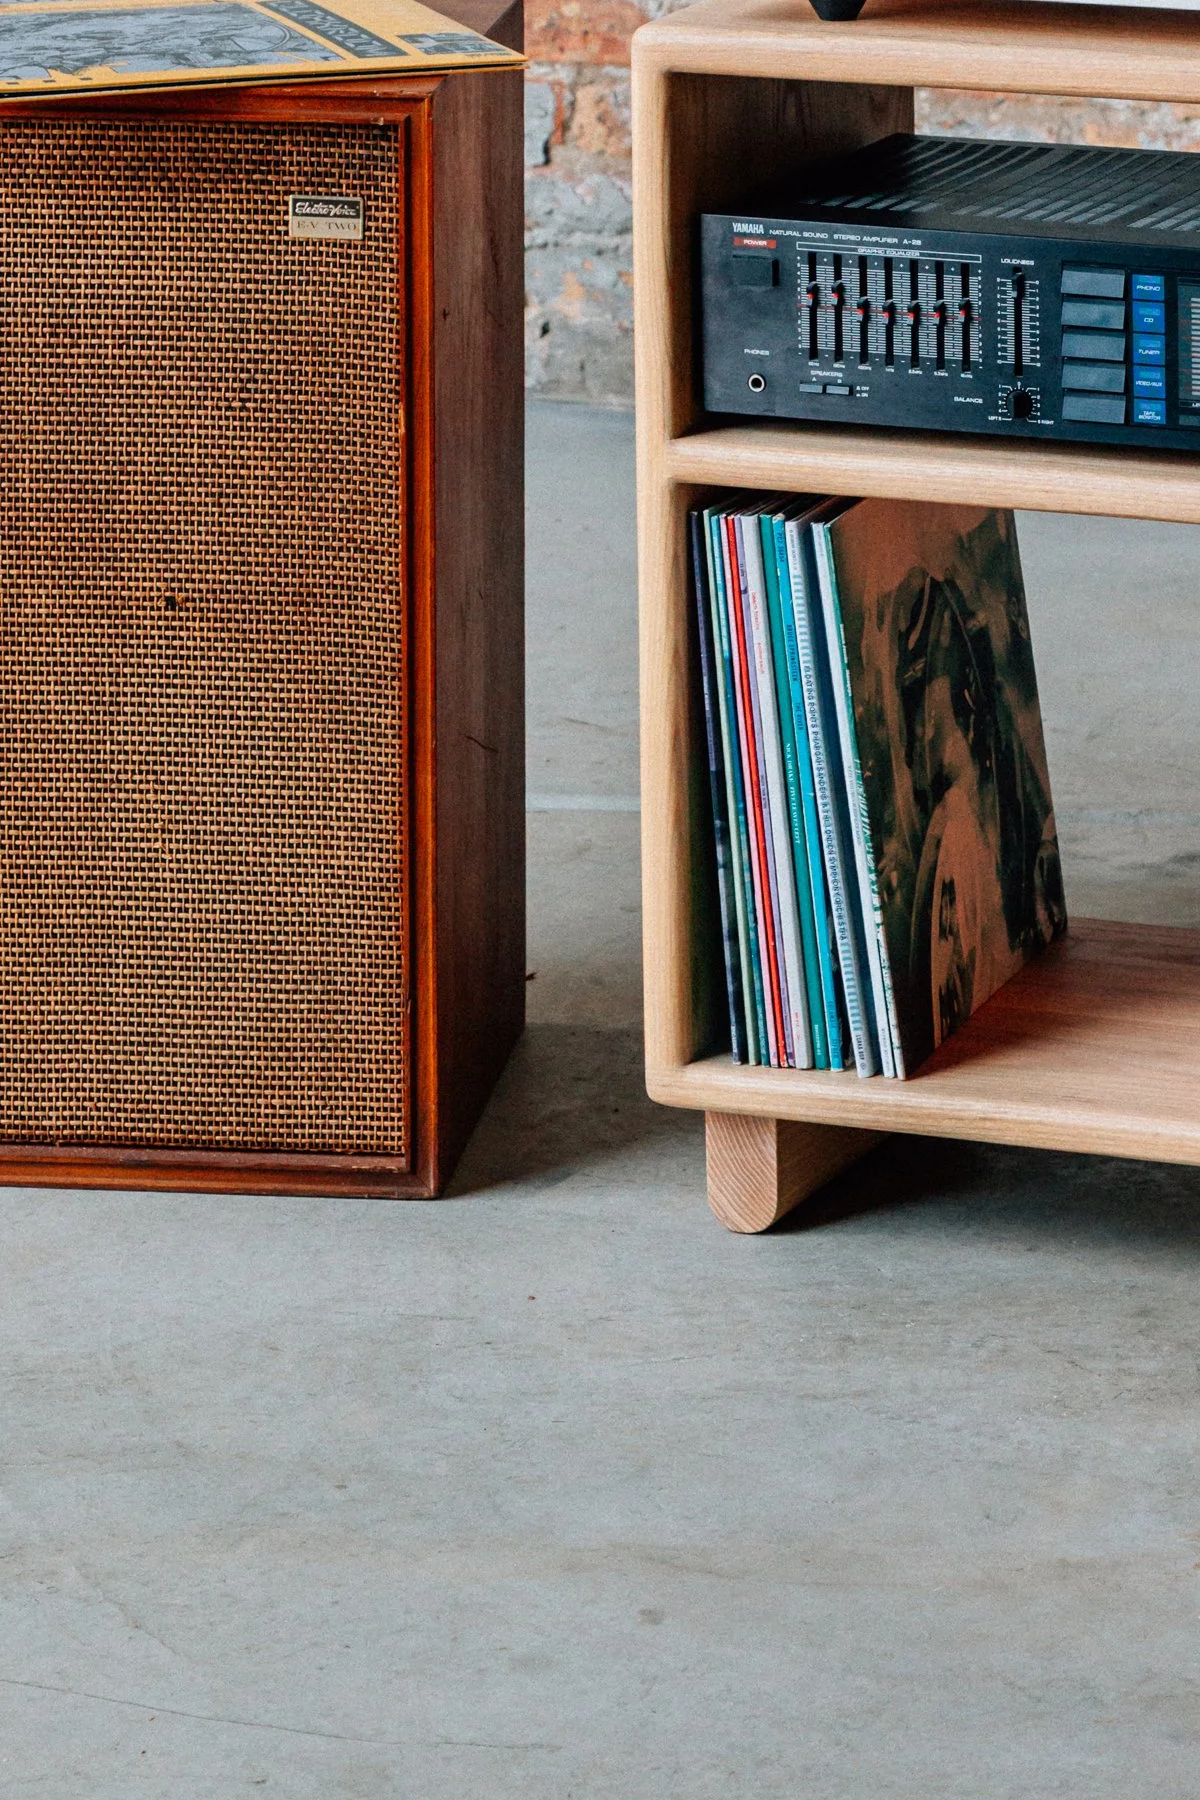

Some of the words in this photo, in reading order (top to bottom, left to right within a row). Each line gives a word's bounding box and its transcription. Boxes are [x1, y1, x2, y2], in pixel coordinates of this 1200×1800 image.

[325, 221, 358, 231] TWO
[732, 222, 764, 234] YAMAHA
[769, 229, 801, 238] NATURAL
[803, 232, 829, 240] SOUND
[833, 233, 862, 242] STEREO
[864, 236, 899, 244] AMPLIFIER
[857, 247, 885, 255] GRAPHIC
[887, 249, 921, 257] EQUALIZER
[1000, 257, 1034, 266] LOUDNESS
[1136, 284, 1161, 293] PHONO
[1138, 349, 1161, 357] TUNER
[810, 370, 843, 378] SPEAKERS
[1135, 379, 1163, 388] VIDEO/AUX
[953, 396, 983, 404] BALANCE
[786, 624, 794, 642] BRUCE
[788, 643, 799, 682] SPRINGSTEEN
[803, 665, 814, 701] FLOATING
[796, 713, 804, 731] RIVER
[807, 701, 818, 729] POINTS
[787, 759, 795, 782] DRAKE
[815, 767, 828, 801] SANDERS
[822, 809, 832, 823] THE
[824, 824, 836, 855] LONDON
[829, 856, 842, 895] SYMPHONY
[834, 896, 849, 942] ORCHESTRA
[855, 1034, 864, 1052] LUAKA
[858, 1052, 866, 1062] BOP
